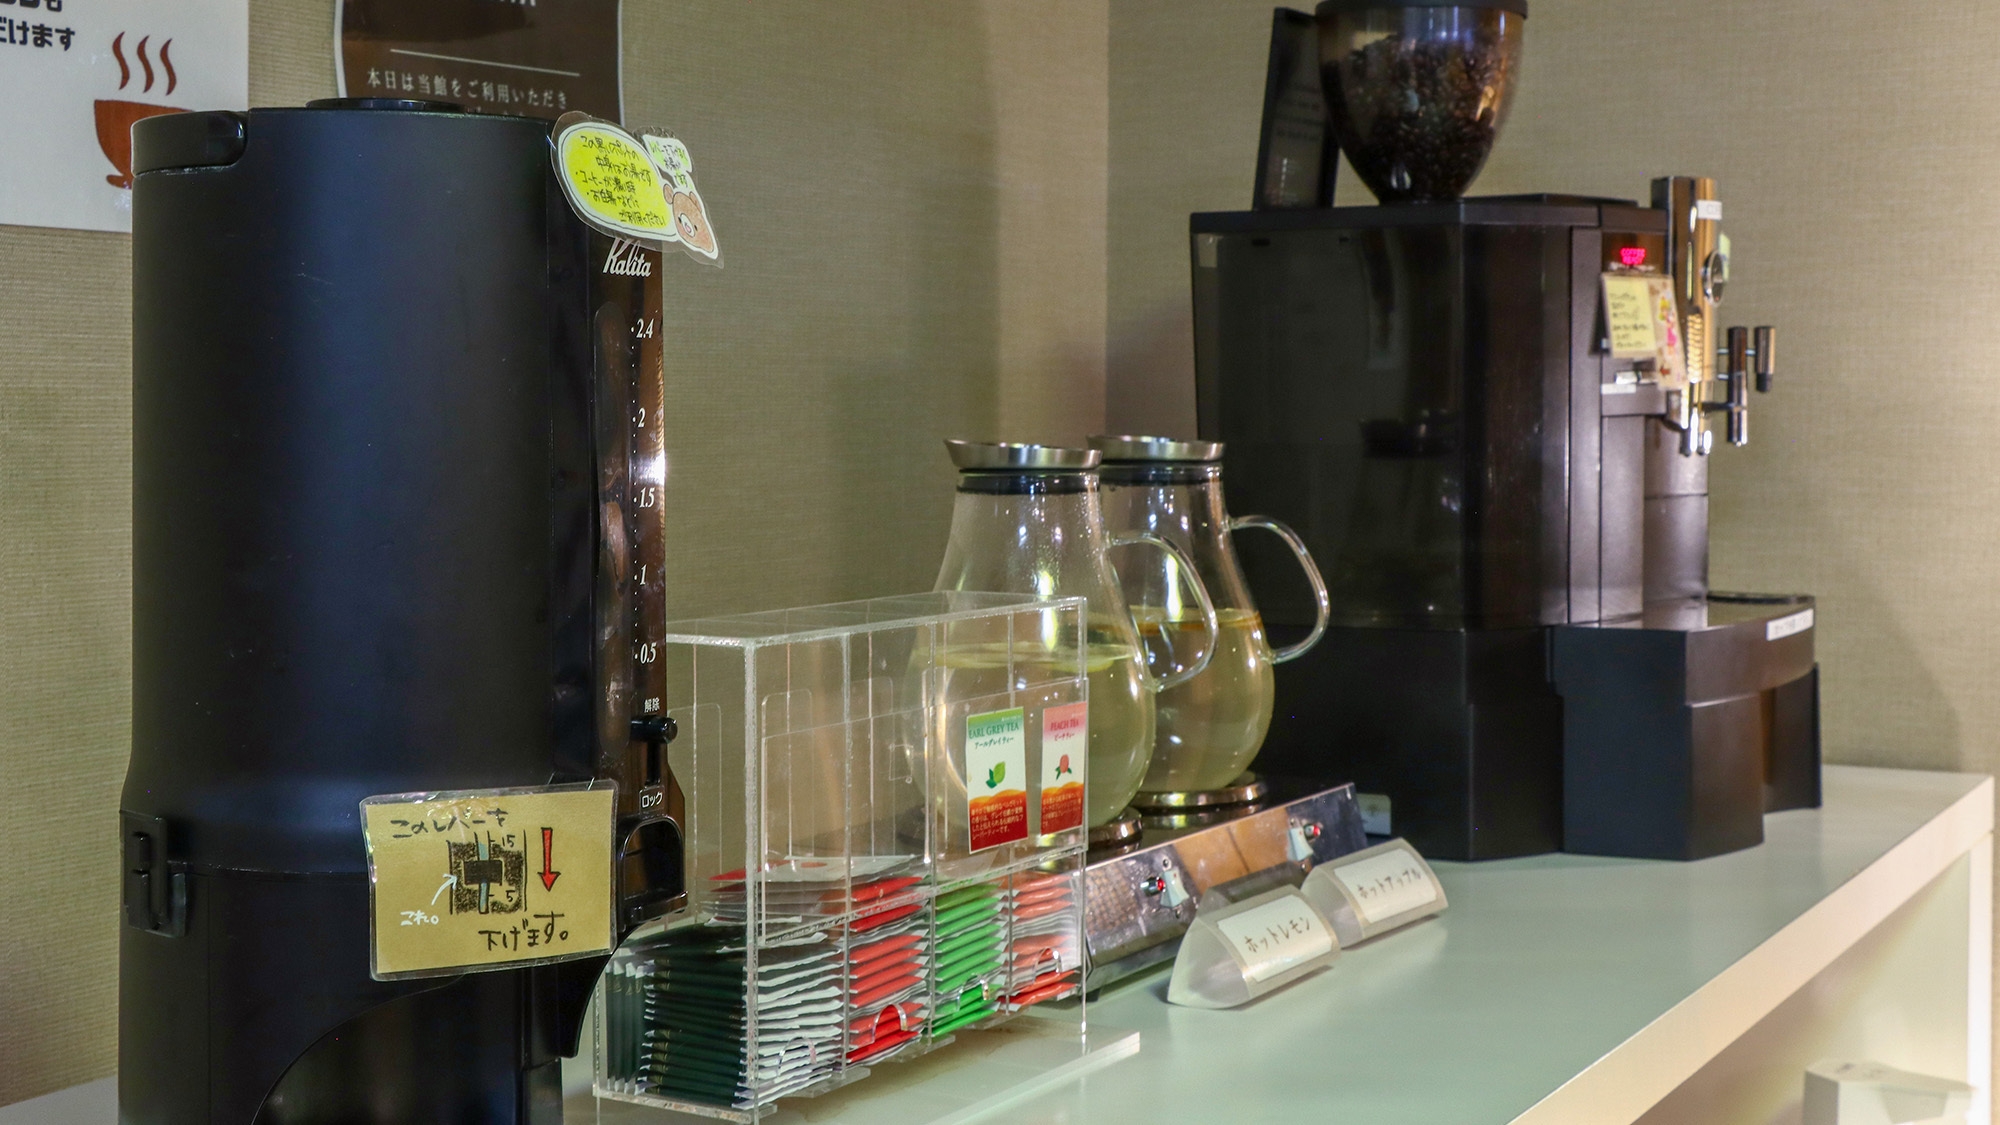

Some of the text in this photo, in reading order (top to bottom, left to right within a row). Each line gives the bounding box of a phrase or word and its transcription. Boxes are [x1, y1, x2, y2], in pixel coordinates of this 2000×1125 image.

[367, 67, 567, 110] 本日は当館をご利用いただき
[602, 238, 652, 278] Kalita
[636, 318, 654, 339] 2.4
[637, 407, 646, 428] 2
[639, 487, 655, 509] 1.5
[640, 564, 647, 586] 1
[640, 642, 657, 664] 0.5
[968, 721, 1020, 739] EARL GREY TEA
[1050, 719, 1080, 731] PEACH TEA
[641, 791, 663, 808] ロック
[501, 835, 516, 848] 15
[1357, 868, 1422, 899] ホットアップル
[505, 890, 516, 902] 5
[478, 911, 569, 951] 下げます。
[1244, 917, 1311, 953] ホットレモン
